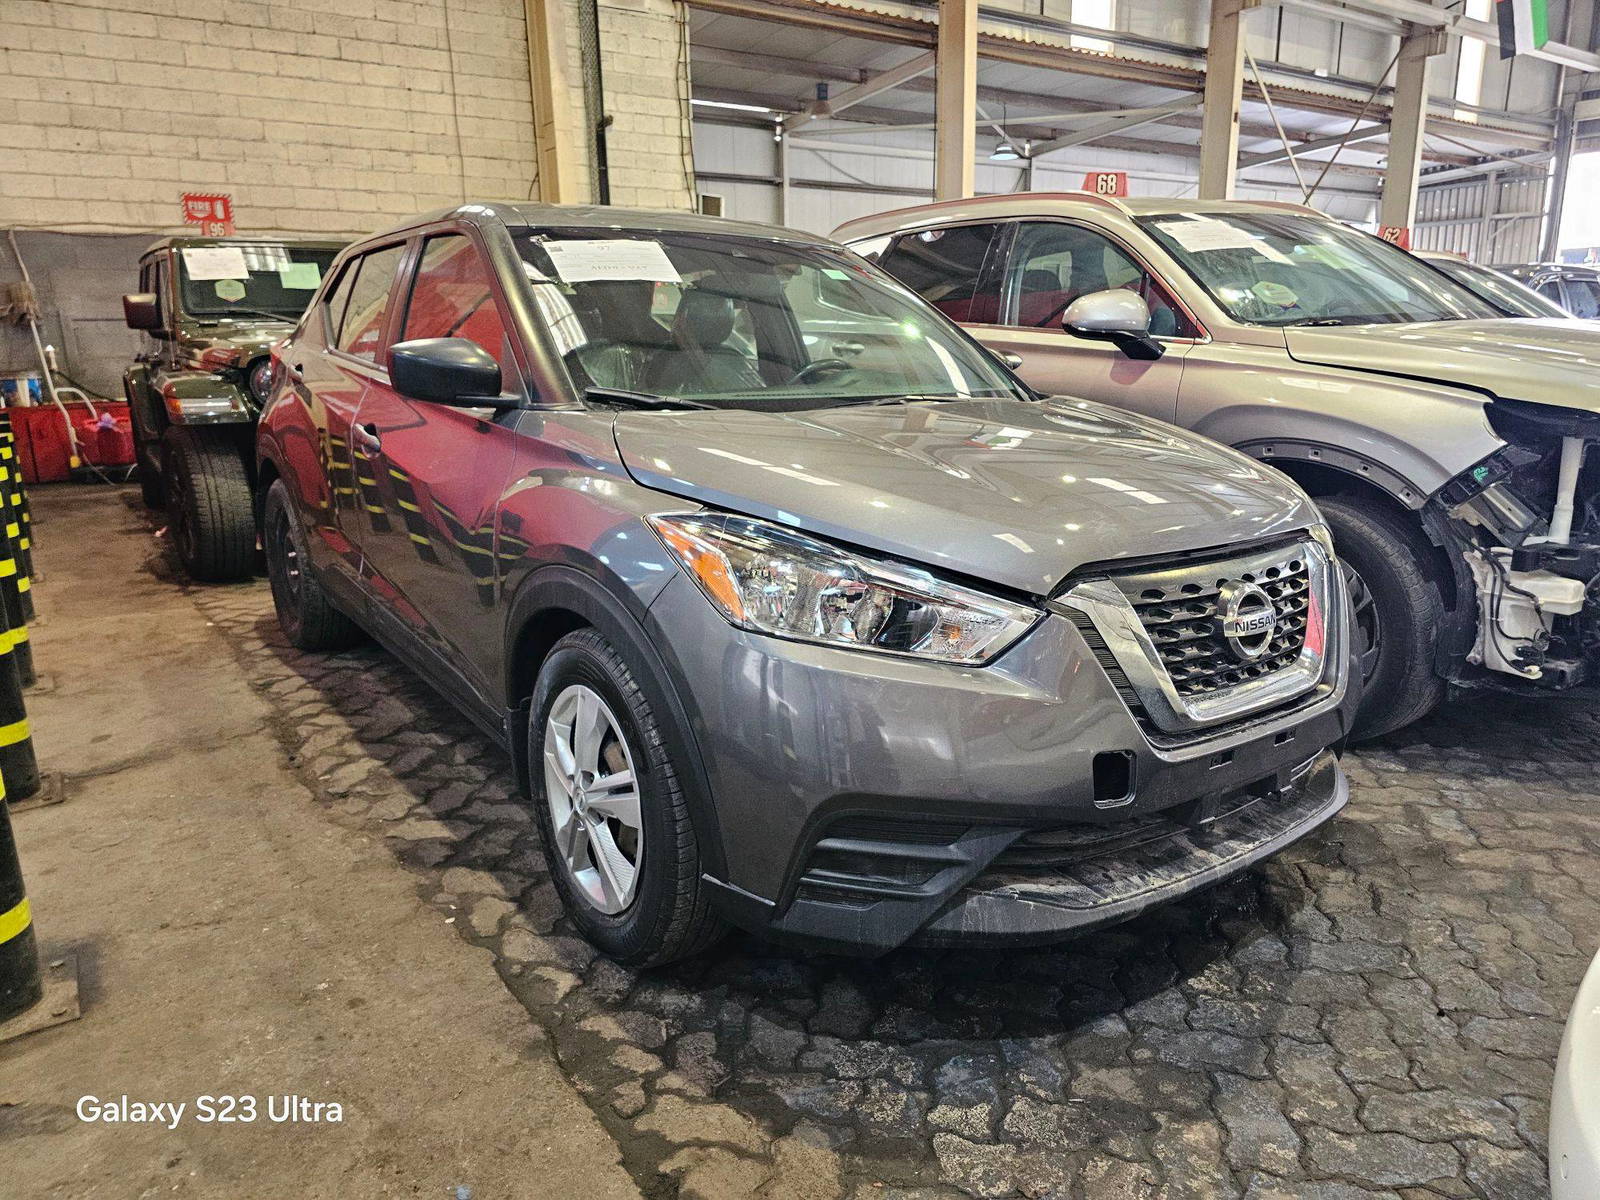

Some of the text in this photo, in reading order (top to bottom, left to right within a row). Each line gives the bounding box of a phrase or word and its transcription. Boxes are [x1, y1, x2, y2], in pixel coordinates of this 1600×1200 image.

[1096, 174, 1117, 195] 68
[187, 200, 211, 211] FIRE
[1383, 227, 1401, 243] 62
[1235, 613, 1276, 633] NISSAN
